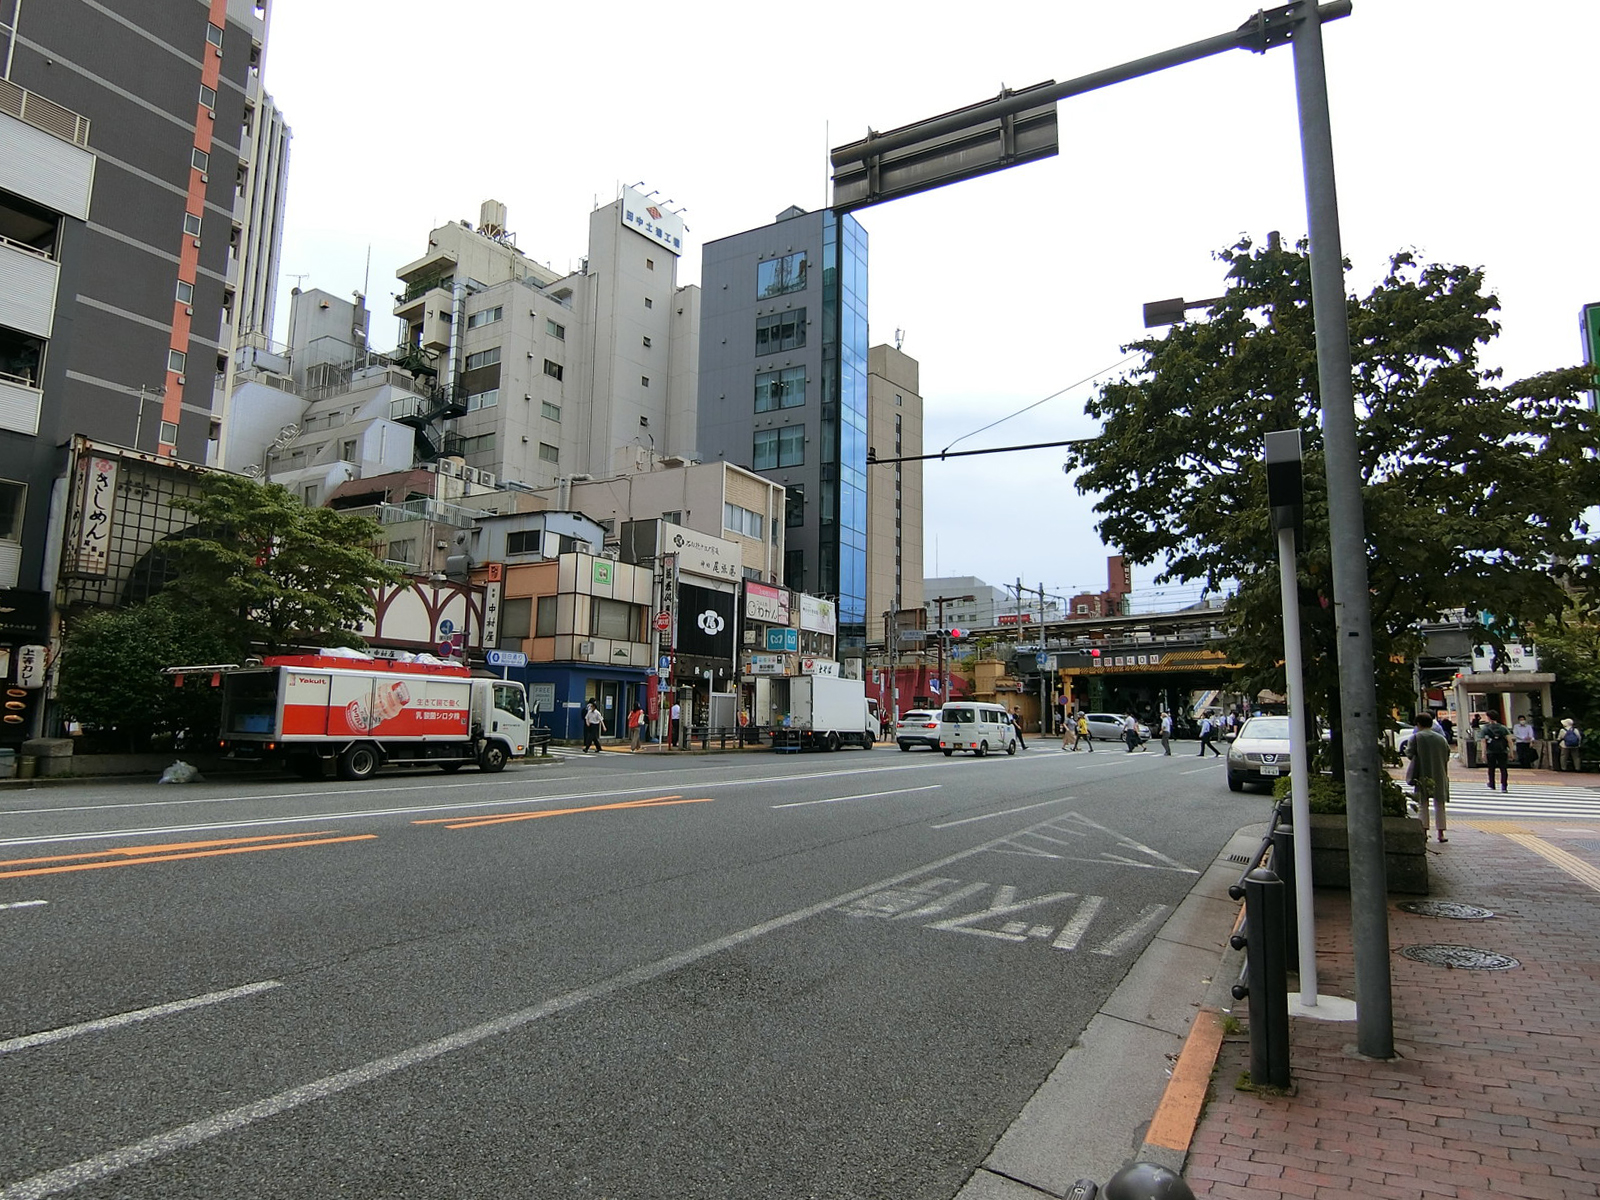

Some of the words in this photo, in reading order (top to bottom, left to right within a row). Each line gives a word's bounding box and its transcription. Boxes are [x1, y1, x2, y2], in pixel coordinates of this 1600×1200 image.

[86, 472, 109, 540] きしめん
[485, 603, 497, 642] 中村屋
[299, 677, 327, 685] Yakult
